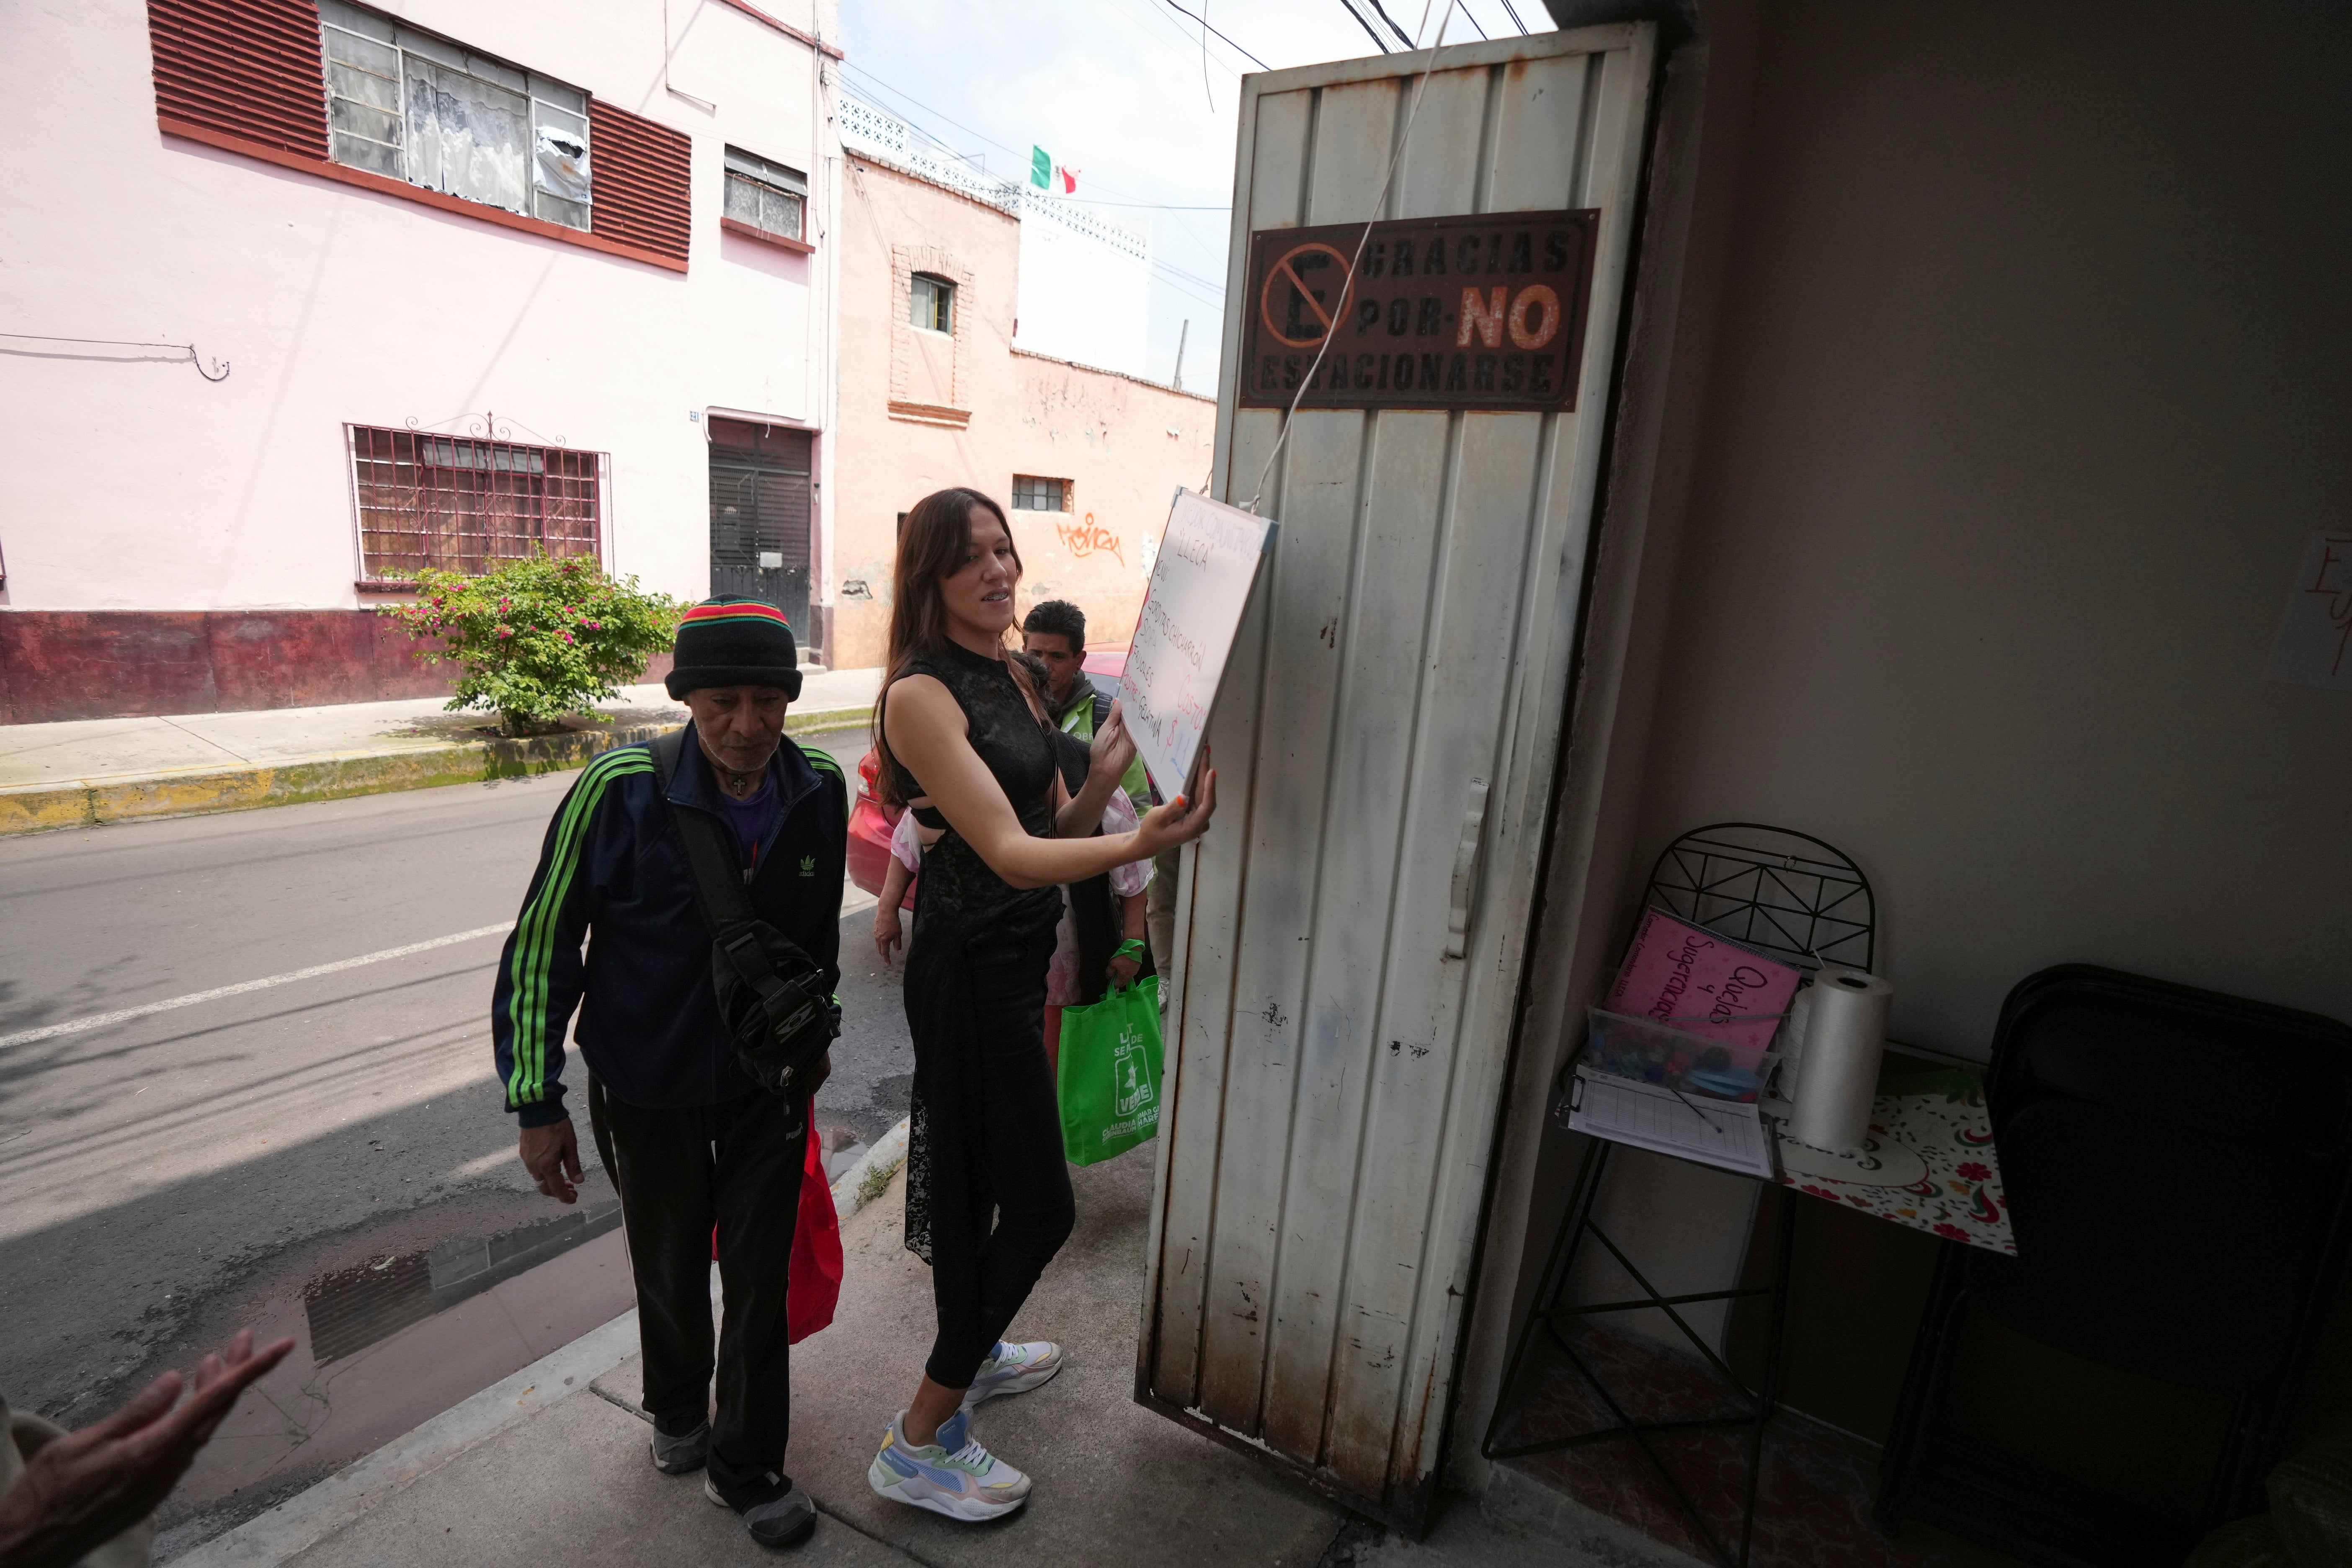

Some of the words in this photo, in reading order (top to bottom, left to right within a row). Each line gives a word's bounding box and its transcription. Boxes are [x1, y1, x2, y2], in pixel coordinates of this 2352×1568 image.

[1362, 231, 1571, 279] GRACIAS
[1358, 297, 1442, 336] POR
[1457, 284, 1560, 349] NO
[1261, 354, 1555, 392] ESTACIONARSE
[1148, 588, 1171, 636] GORDITAS
[1168, 624, 1206, 673] CHICHARRÓN
[1132, 645, 1153, 687] FRIJOLES
[1640, 914, 1659, 941] Comedor
[1710, 966, 1768, 1024] Quejas
[1102, 1119, 1136, 1137] CLAUDIA
[1137, 1109, 1152, 1120] OMAR
